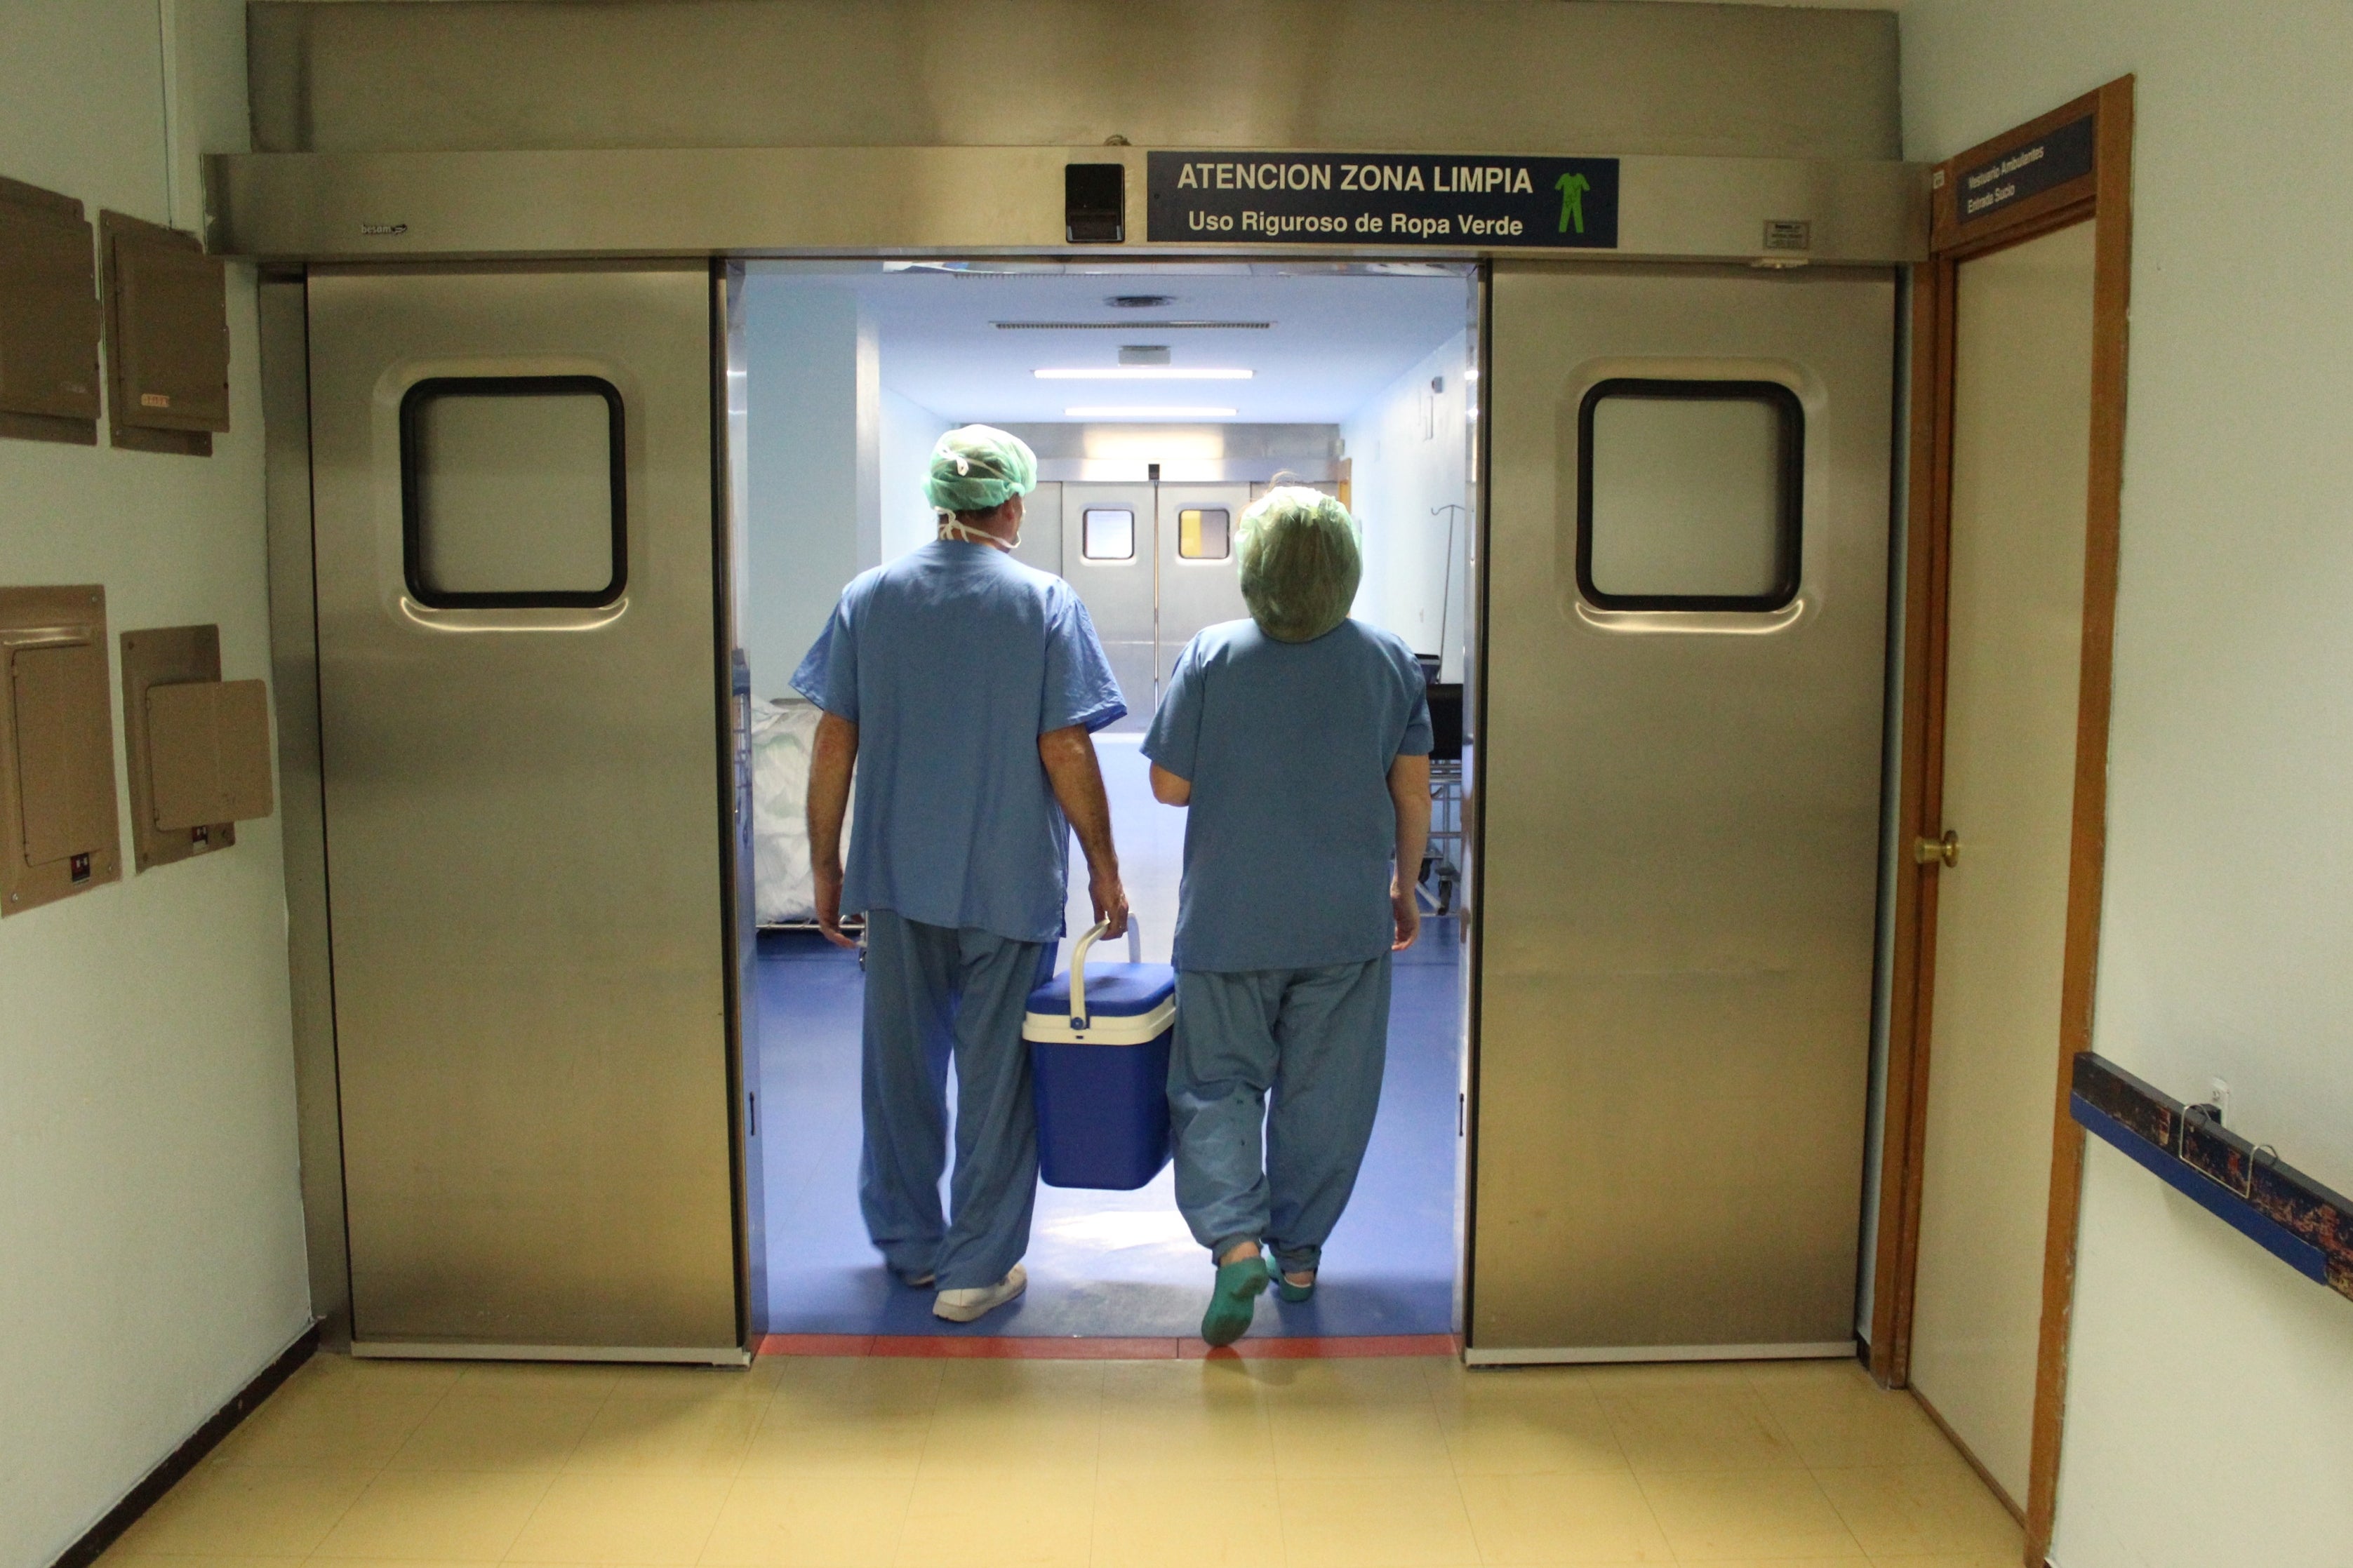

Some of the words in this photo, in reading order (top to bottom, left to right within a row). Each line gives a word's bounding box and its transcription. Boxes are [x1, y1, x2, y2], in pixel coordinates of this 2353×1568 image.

[1177, 163, 1331, 191] ATENCION
[1340, 165, 1425, 192] ZONA
[1434, 166, 1533, 193] LIMPIA
[1994, 183, 2015, 202] Sucio
[1188, 210, 1234, 231] Uso
[1242, 211, 1347, 236] Riguroso
[1354, 213, 1383, 233] de
[1391, 213, 1450, 239] Ropa
[1458, 215, 1523, 236] Verde
